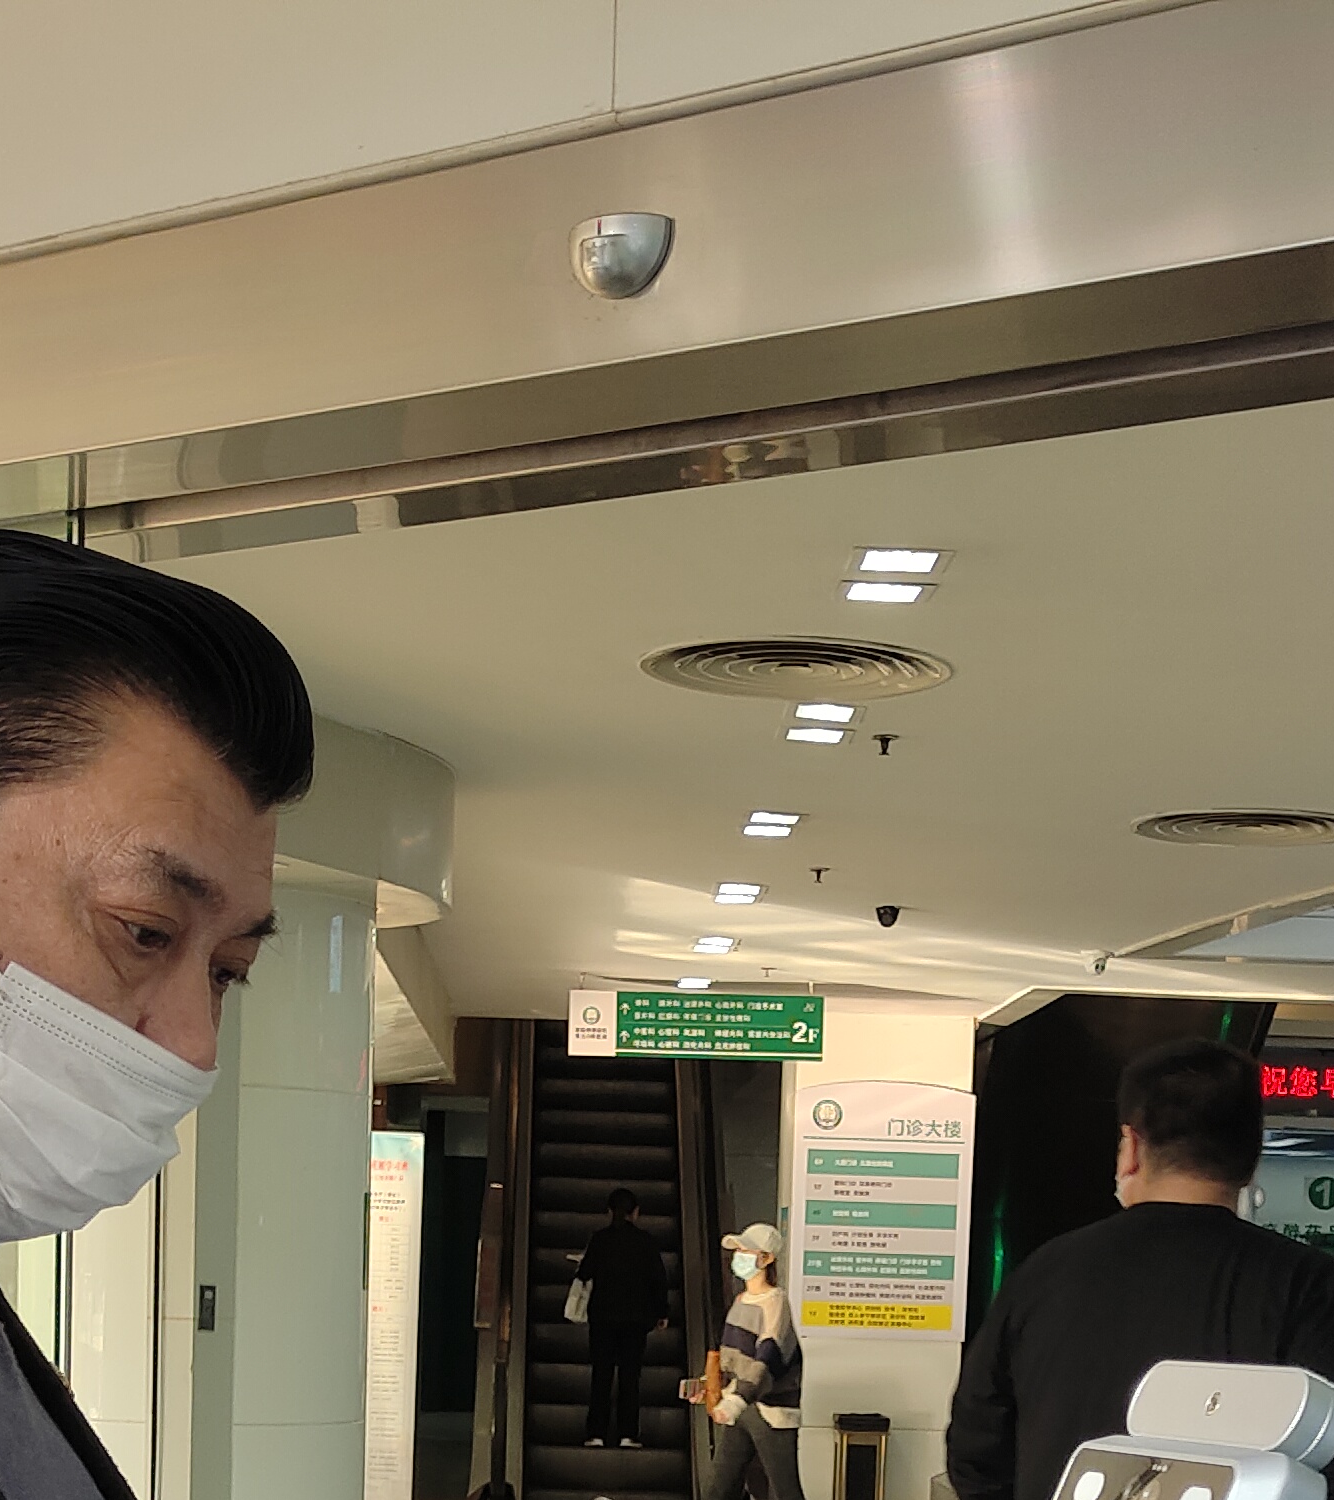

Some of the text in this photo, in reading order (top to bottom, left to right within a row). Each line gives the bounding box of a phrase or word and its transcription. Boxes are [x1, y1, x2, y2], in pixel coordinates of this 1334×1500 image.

[791, 1021, 820, 1044] 2F
[887, 1117, 962, 1138] 门诊大楼
